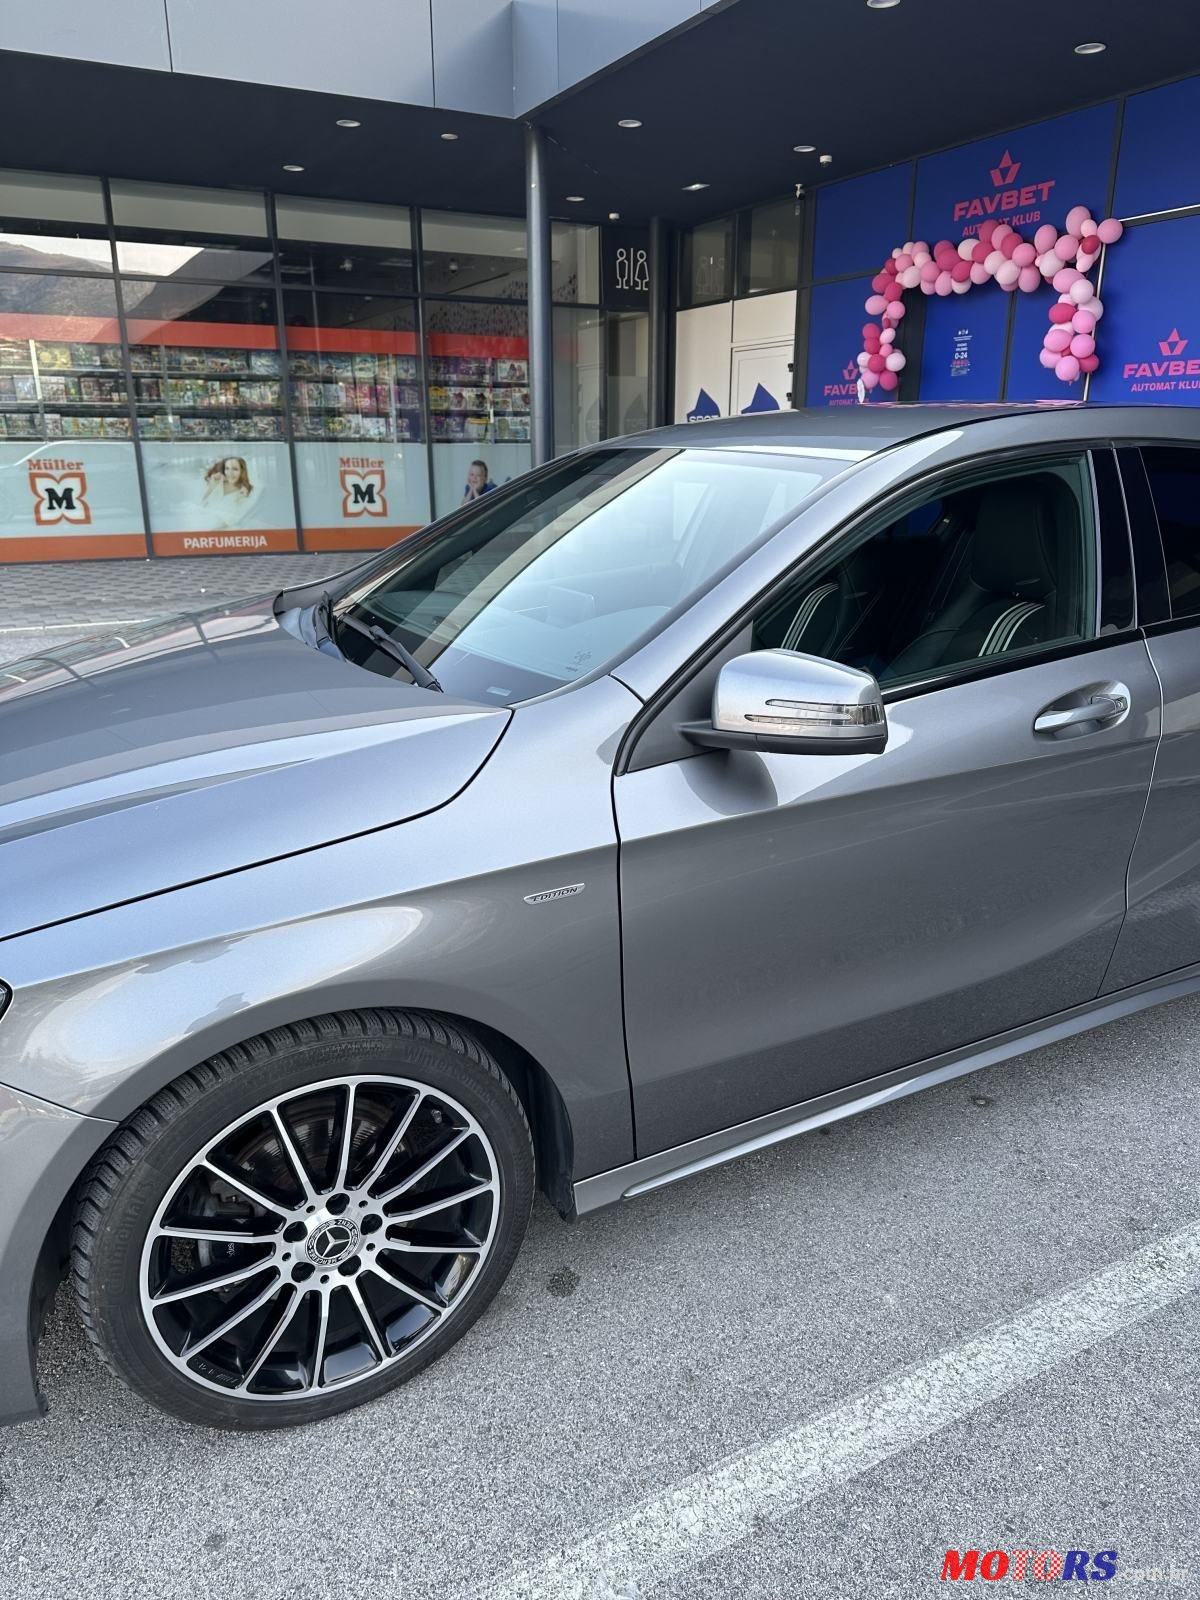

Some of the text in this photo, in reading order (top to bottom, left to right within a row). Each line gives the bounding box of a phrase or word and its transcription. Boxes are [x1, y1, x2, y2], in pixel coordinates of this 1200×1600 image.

[954, 181, 1055, 221] FAVBET
[1012, 211, 1041, 226] KLUB
[954, 352, 968, 360] 0-24
[1123, 359, 1200, 379] FAVBE
[823, 383, 858, 397] FAVB
[1130, 379, 1200, 393] AUTOMAT KLU
[27, 458, 84, 471] Müller
[338, 457, 385, 469] Müller
[44, 487, 77, 510] M
[352, 483, 377, 504] M
[183, 535, 269, 549] PARFUMERIJA
